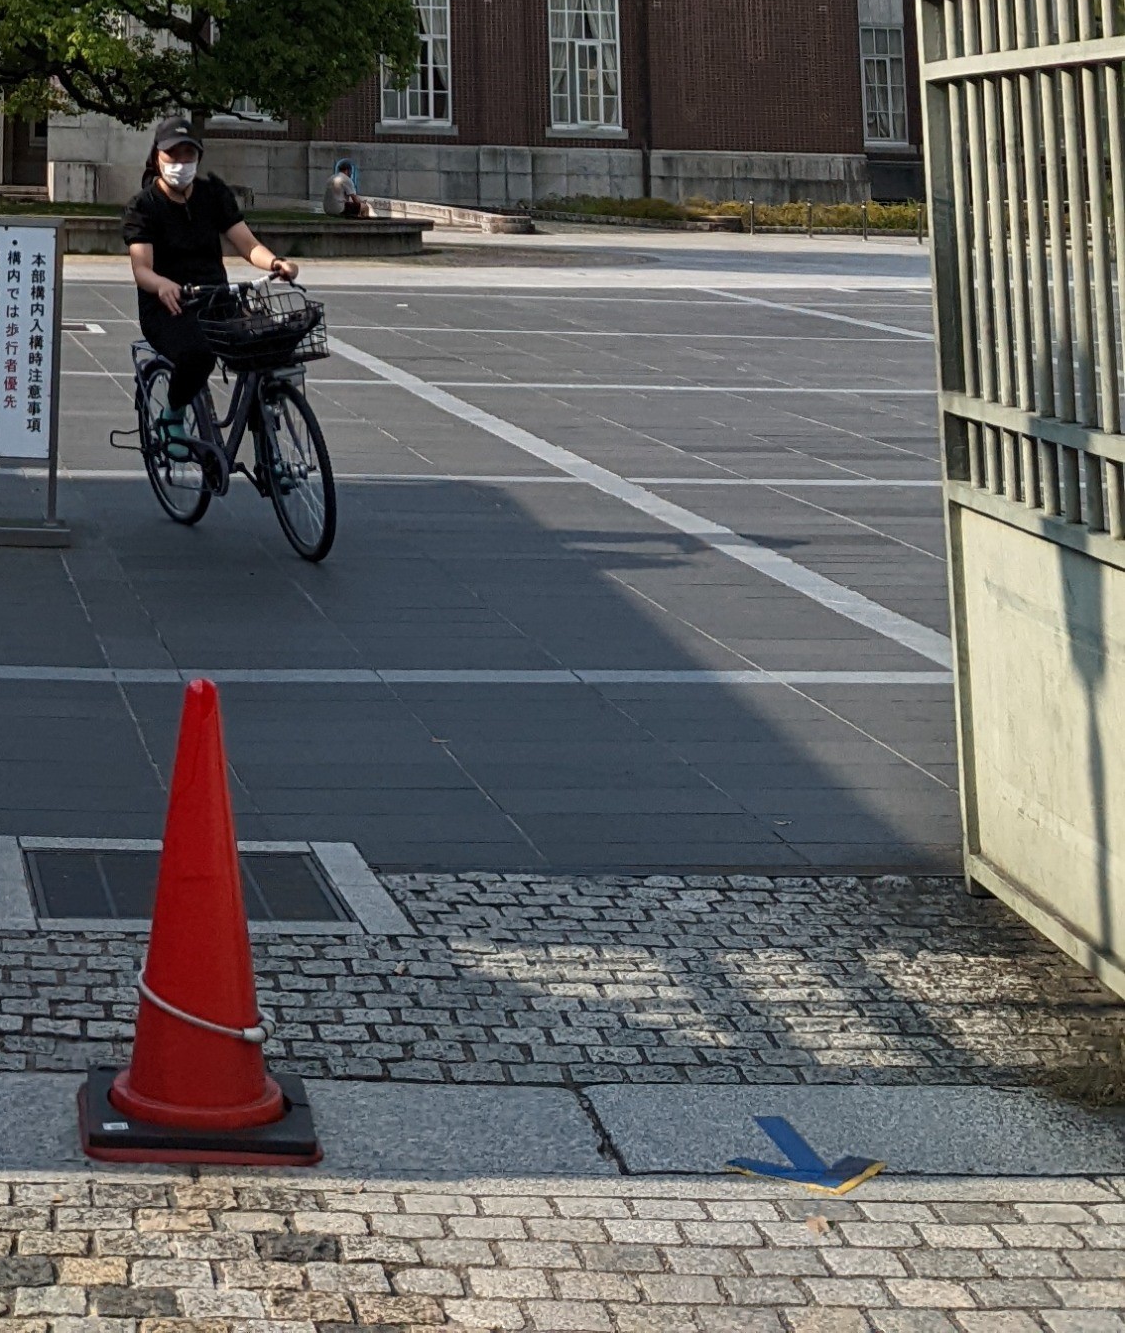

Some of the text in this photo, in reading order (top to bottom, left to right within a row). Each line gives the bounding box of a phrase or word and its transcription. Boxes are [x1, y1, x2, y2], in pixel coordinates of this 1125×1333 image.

[3, 250, 21, 409] 構内では歩行者優先
[26, 252, 46, 433] 本部構内入構時注意事項
